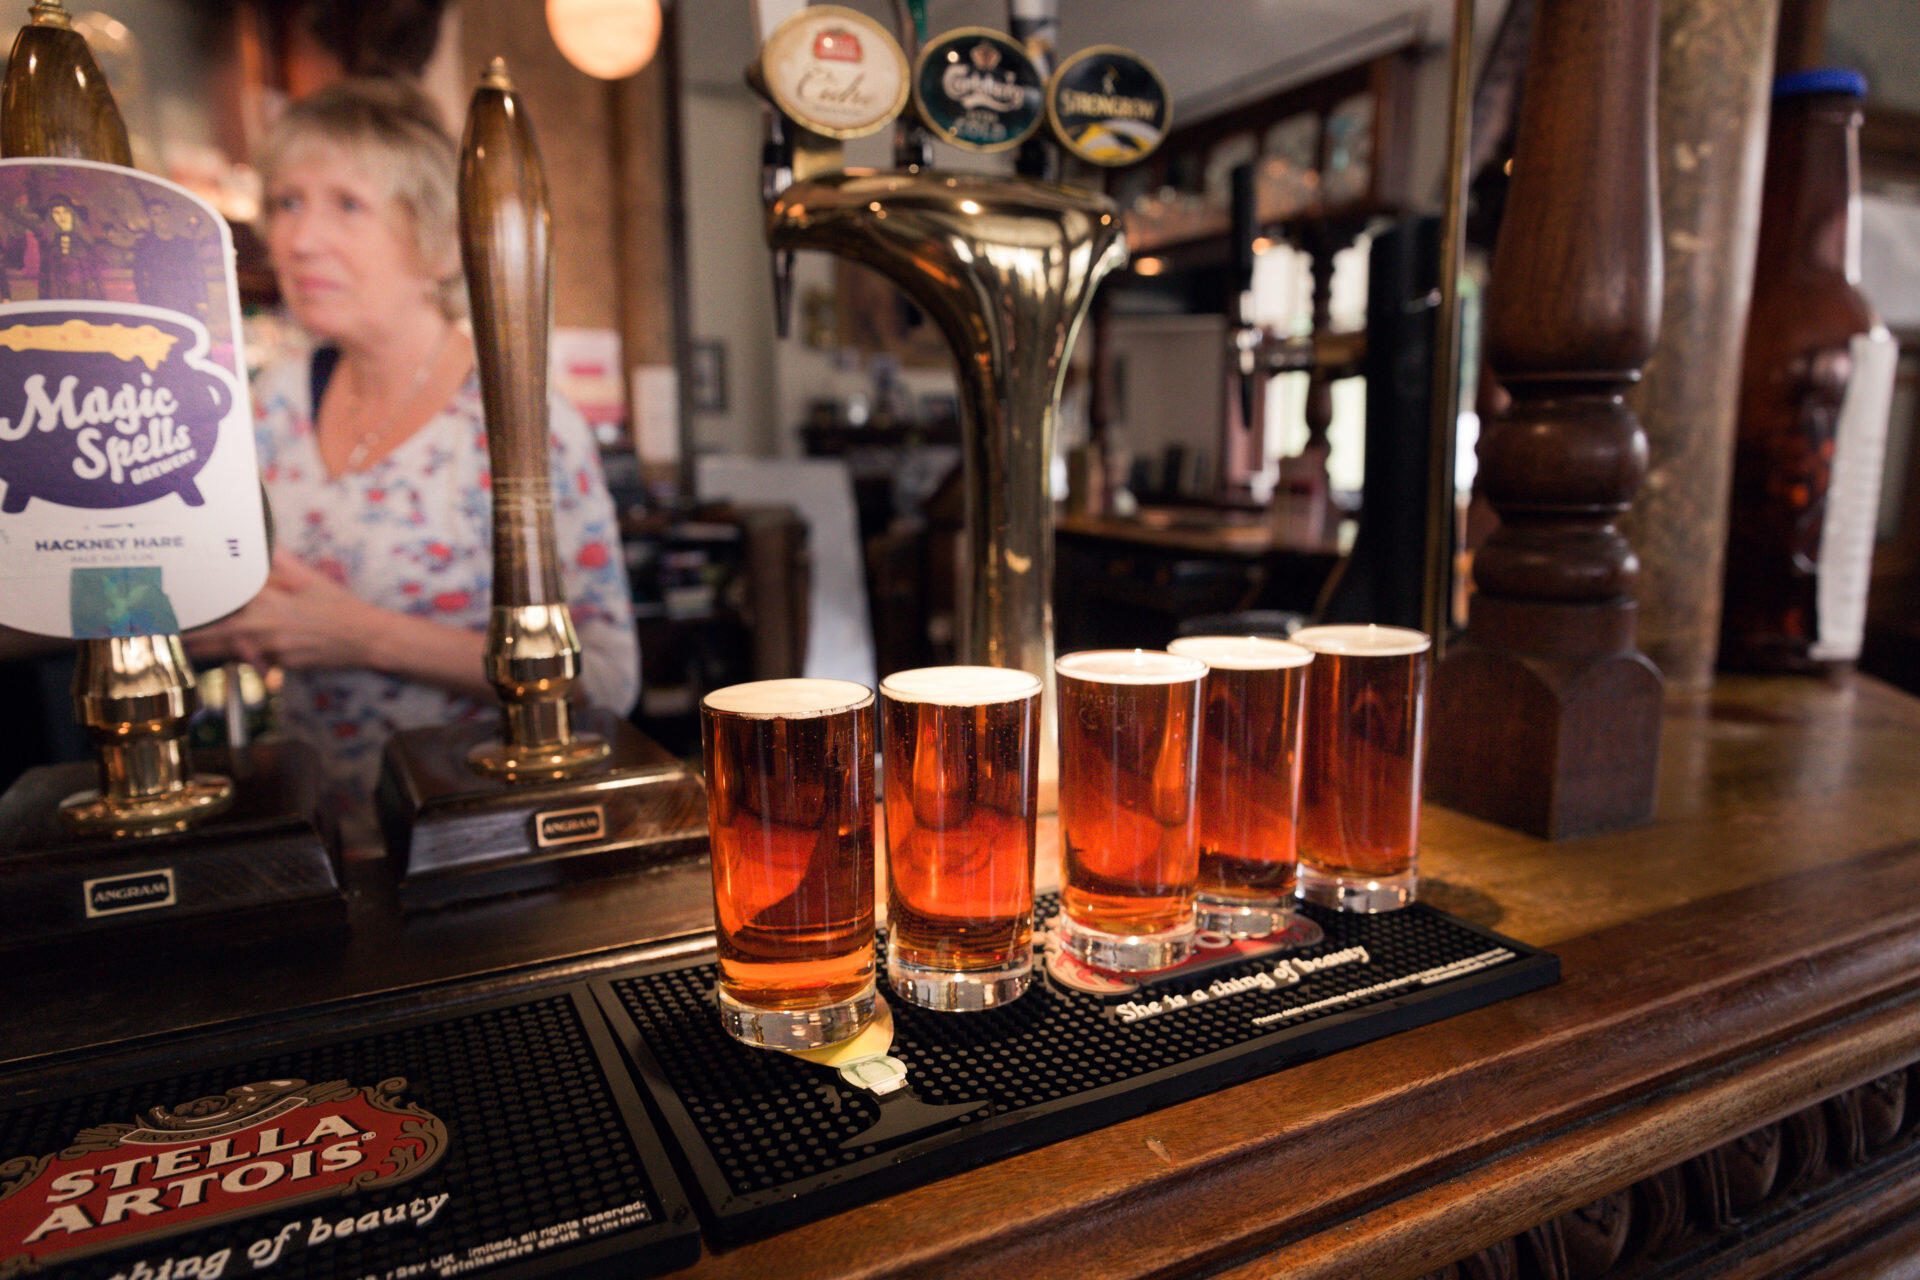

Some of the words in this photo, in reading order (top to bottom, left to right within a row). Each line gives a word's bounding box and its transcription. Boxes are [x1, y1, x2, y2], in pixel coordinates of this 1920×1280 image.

[1060, 88, 1157, 119] STRONGBOW
[0, 372, 178, 441] Magic
[72, 416, 191, 484] Spells
[35, 537, 127, 551] HACKNEY
[133, 536, 184, 548] HARE
[94, 882, 167, 902] ANGRAM
[1116, 1001, 1163, 1023] She
[1163, 995, 1187, 1010] is
[1192, 989, 1210, 1001] a
[1209, 972, 1276, 994] thing
[1274, 959, 1300, 983] of
[1291, 945, 1370, 973] beauty
[22, 1141, 365, 1244] ARTOIS
[46, 1115, 360, 1203] STELLA
[247, 1221, 301, 1269] of
[307, 1192, 450, 1246] beauty
